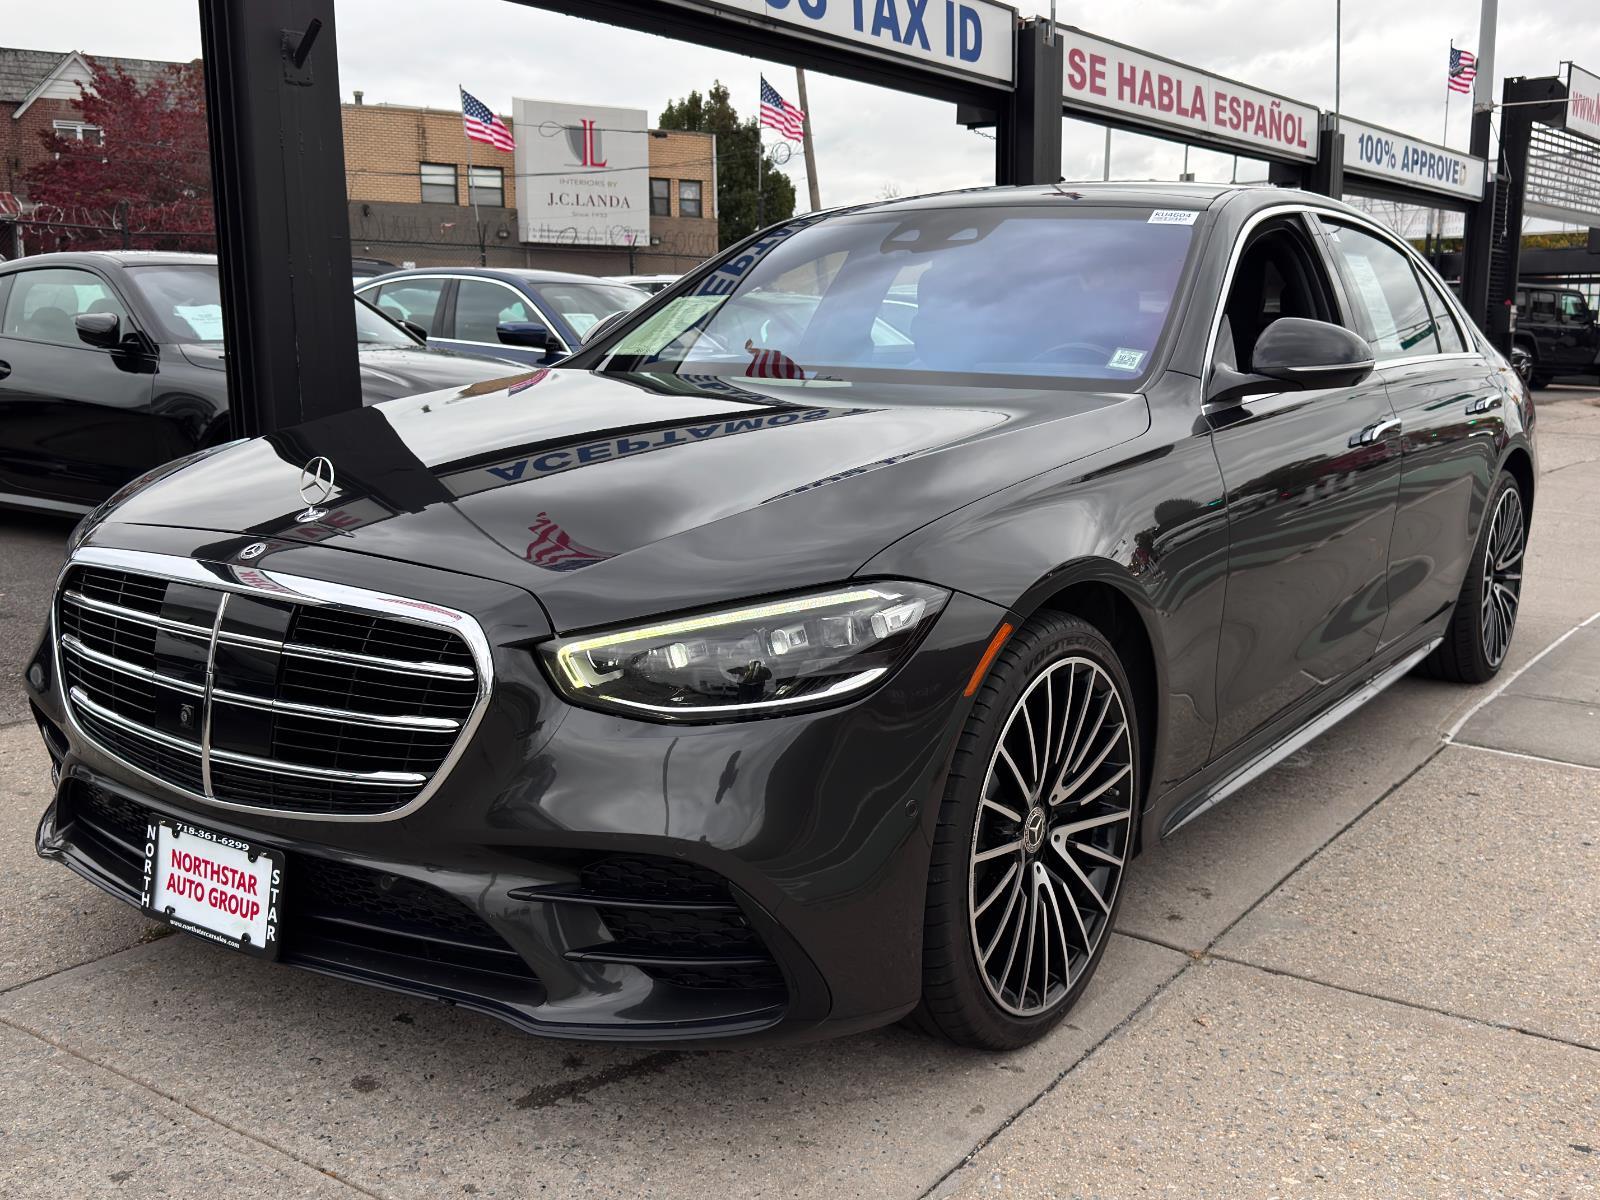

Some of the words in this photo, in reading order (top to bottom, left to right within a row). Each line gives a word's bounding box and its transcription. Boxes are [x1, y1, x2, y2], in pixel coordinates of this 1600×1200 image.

[946, 0, 983, 63] ID
[1067, 48, 1107, 97] SE
[1117, 61, 1207, 122] HABLA
[1214, 90, 1307, 149] ESPAÑOL
[559, 178, 606, 188] INTERIORS
[1358, 133, 1397, 170] 100%
[1401, 145, 1467, 186] APPROVED
[176, 822, 250, 851] 718-361-6299
[141, 824, 156, 908] NORTH
[171, 848, 258, 896] NORTHSTAR
[166, 872, 205, 903] AUTO
[208, 887, 260, 921] GROUP
[266, 869, 281, 942] STAR
